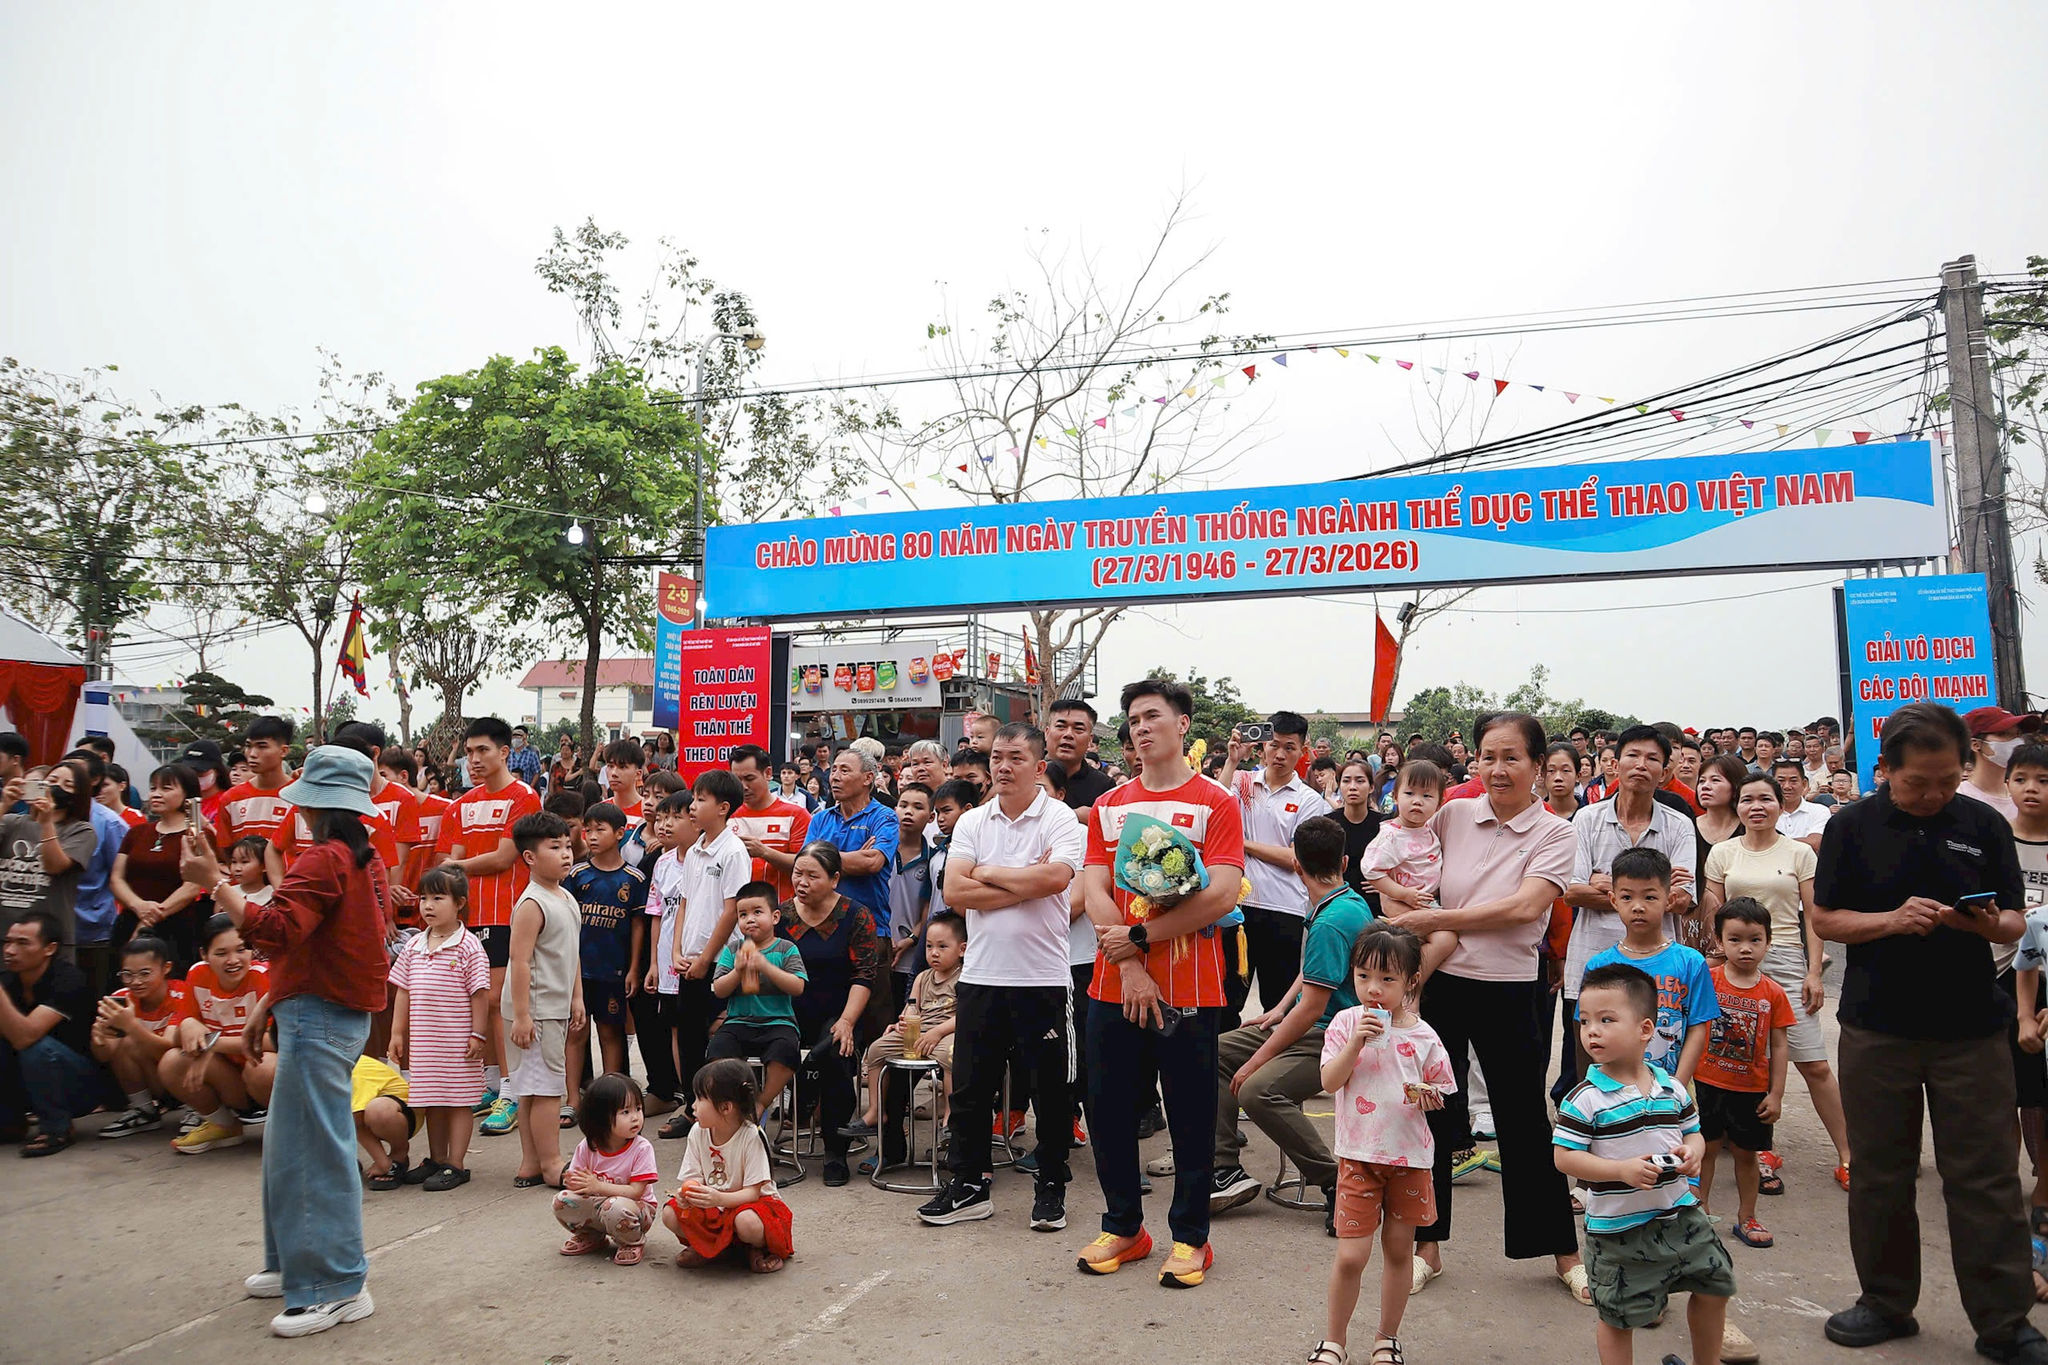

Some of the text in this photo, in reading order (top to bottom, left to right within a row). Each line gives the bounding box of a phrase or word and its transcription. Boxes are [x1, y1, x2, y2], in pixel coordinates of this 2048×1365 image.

[756, 471, 1855, 570] CHÀO MỪNG 80 NĂM NGÀY TRUYỀN THỐNG NGÀNH THỂ DỤC THỂ THAO VIỆT NAM
[1092, 540, 1420, 588] (27/3/1946 - 27/3/2026)
[667, 583, 689, 604] 2-9
[1866, 631, 1975, 664] GIẢI VÔ ĐỊCH
[694, 665, 755, 685] TOÀN DÂN
[1859, 673, 1988, 703] CÁC ĐỘI MẠNH
[690, 691, 757, 712] RÈN LUYỆN
[694, 718, 726, 736] THÂN
[685, 747, 715, 762] THEO
[580, 901, 626, 919] mirates
[590, 916, 617, 928] BETTER
